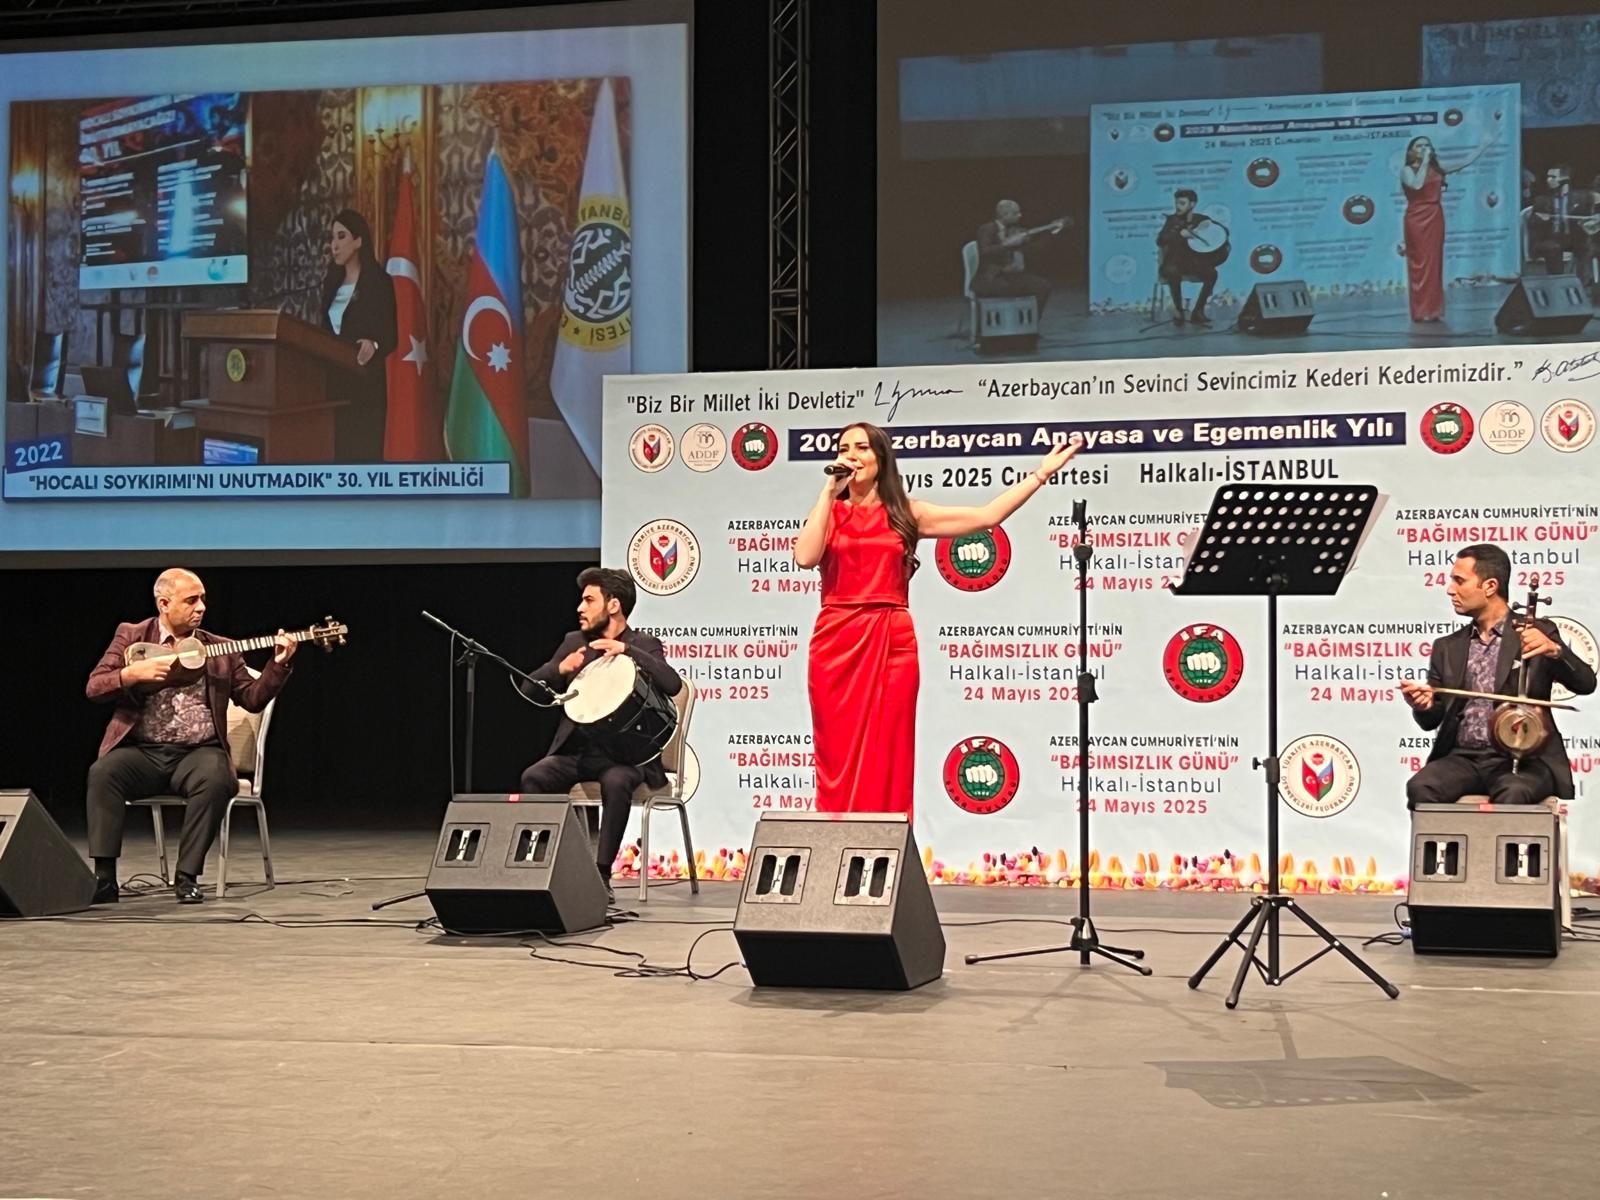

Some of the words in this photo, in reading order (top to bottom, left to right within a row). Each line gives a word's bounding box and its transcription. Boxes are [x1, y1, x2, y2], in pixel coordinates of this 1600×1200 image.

[1123, 373, 1189, 394] Sevinci
[1197, 370, 1297, 391] Sevincimiz
[1306, 366, 1369, 387] Kederi
[627, 395, 662, 413] "Biz
[670, 394, 695, 412] Bir
[703, 393, 750, 412] Millet
[758, 387, 779, 411] İki
[788, 389, 865, 410] Devletiz"
[891, 430, 1022, 453] zerbaycan
[1152, 428, 1184, 443] ve
[1193, 419, 1337, 446] Egemenlik
[1346, 417, 1394, 438] Yılı
[15, 441, 64, 467] 2022
[29, 475, 98, 490] "HOCALI
[103, 473, 214, 490] SOYKIRIMI'NI
[219, 472, 332, 489] UNUTMADIK"
[337, 473, 363, 488] 30.
[367, 472, 393, 487] YIL
[398, 467, 484, 487] ETKİNLİĞİ
[900, 472, 933, 493] yıs
[942, 467, 992, 488] 2025
[1001, 464, 1109, 487] Cuartesi
[1140, 456, 1339, 484] Halkalı-İSTANBUL
[1129, 511, 1207, 525] CUMHURİYET
[1395, 509, 1479, 521] AZERBAYCAN
[728, 519, 800, 531] AZERBAYCAN
[1396, 523, 1528, 543] “BAĞIMSIZLIK
[751, 579, 771, 592] 24
[1103, 576, 1153, 593] Mayıs
[1424, 572, 1447, 587] 24
[939, 626, 1015, 637] AZERBAYCAN
[1017, 622, 1123, 637] CUMHURİYTİ’NİN
[1282, 623, 1365, 635] AZERBAYCAN
[661, 640, 738, 658] ĞIMSIZLIK
[939, 640, 1059, 659] “BAĞIMSIZLIK
[1064, 639, 1122, 658] GNÜ”
[1284, 638, 1413, 658] “BAĞIMSIZLIK
[678, 661, 782, 680] alı-İstanbul
[1295, 659, 1429, 681] Halkalı-İstan
[729, 686, 769, 700] 2025
[963, 686, 985, 701] 24
[991, 686, 1041, 703] Mayıs
[1048, 686, 1081, 701] 202
[1311, 686, 1333, 701] 24
[1341, 686, 1395, 704] Mayıs
[728, 734, 801, 745] AZERBAYCAN
[1050, 735, 1127, 747] AZERAYCAN
[729, 748, 816, 767] “BAĞIMSIZ
[739, 770, 816, 789] Halkalı-İ
[1061, 773, 1222, 793] Hlkalı-İstanbul
[753, 795, 773, 808] 24
[1104, 798, 1155, 815] Mayıs
[1163, 799, 1208, 814] 2025
